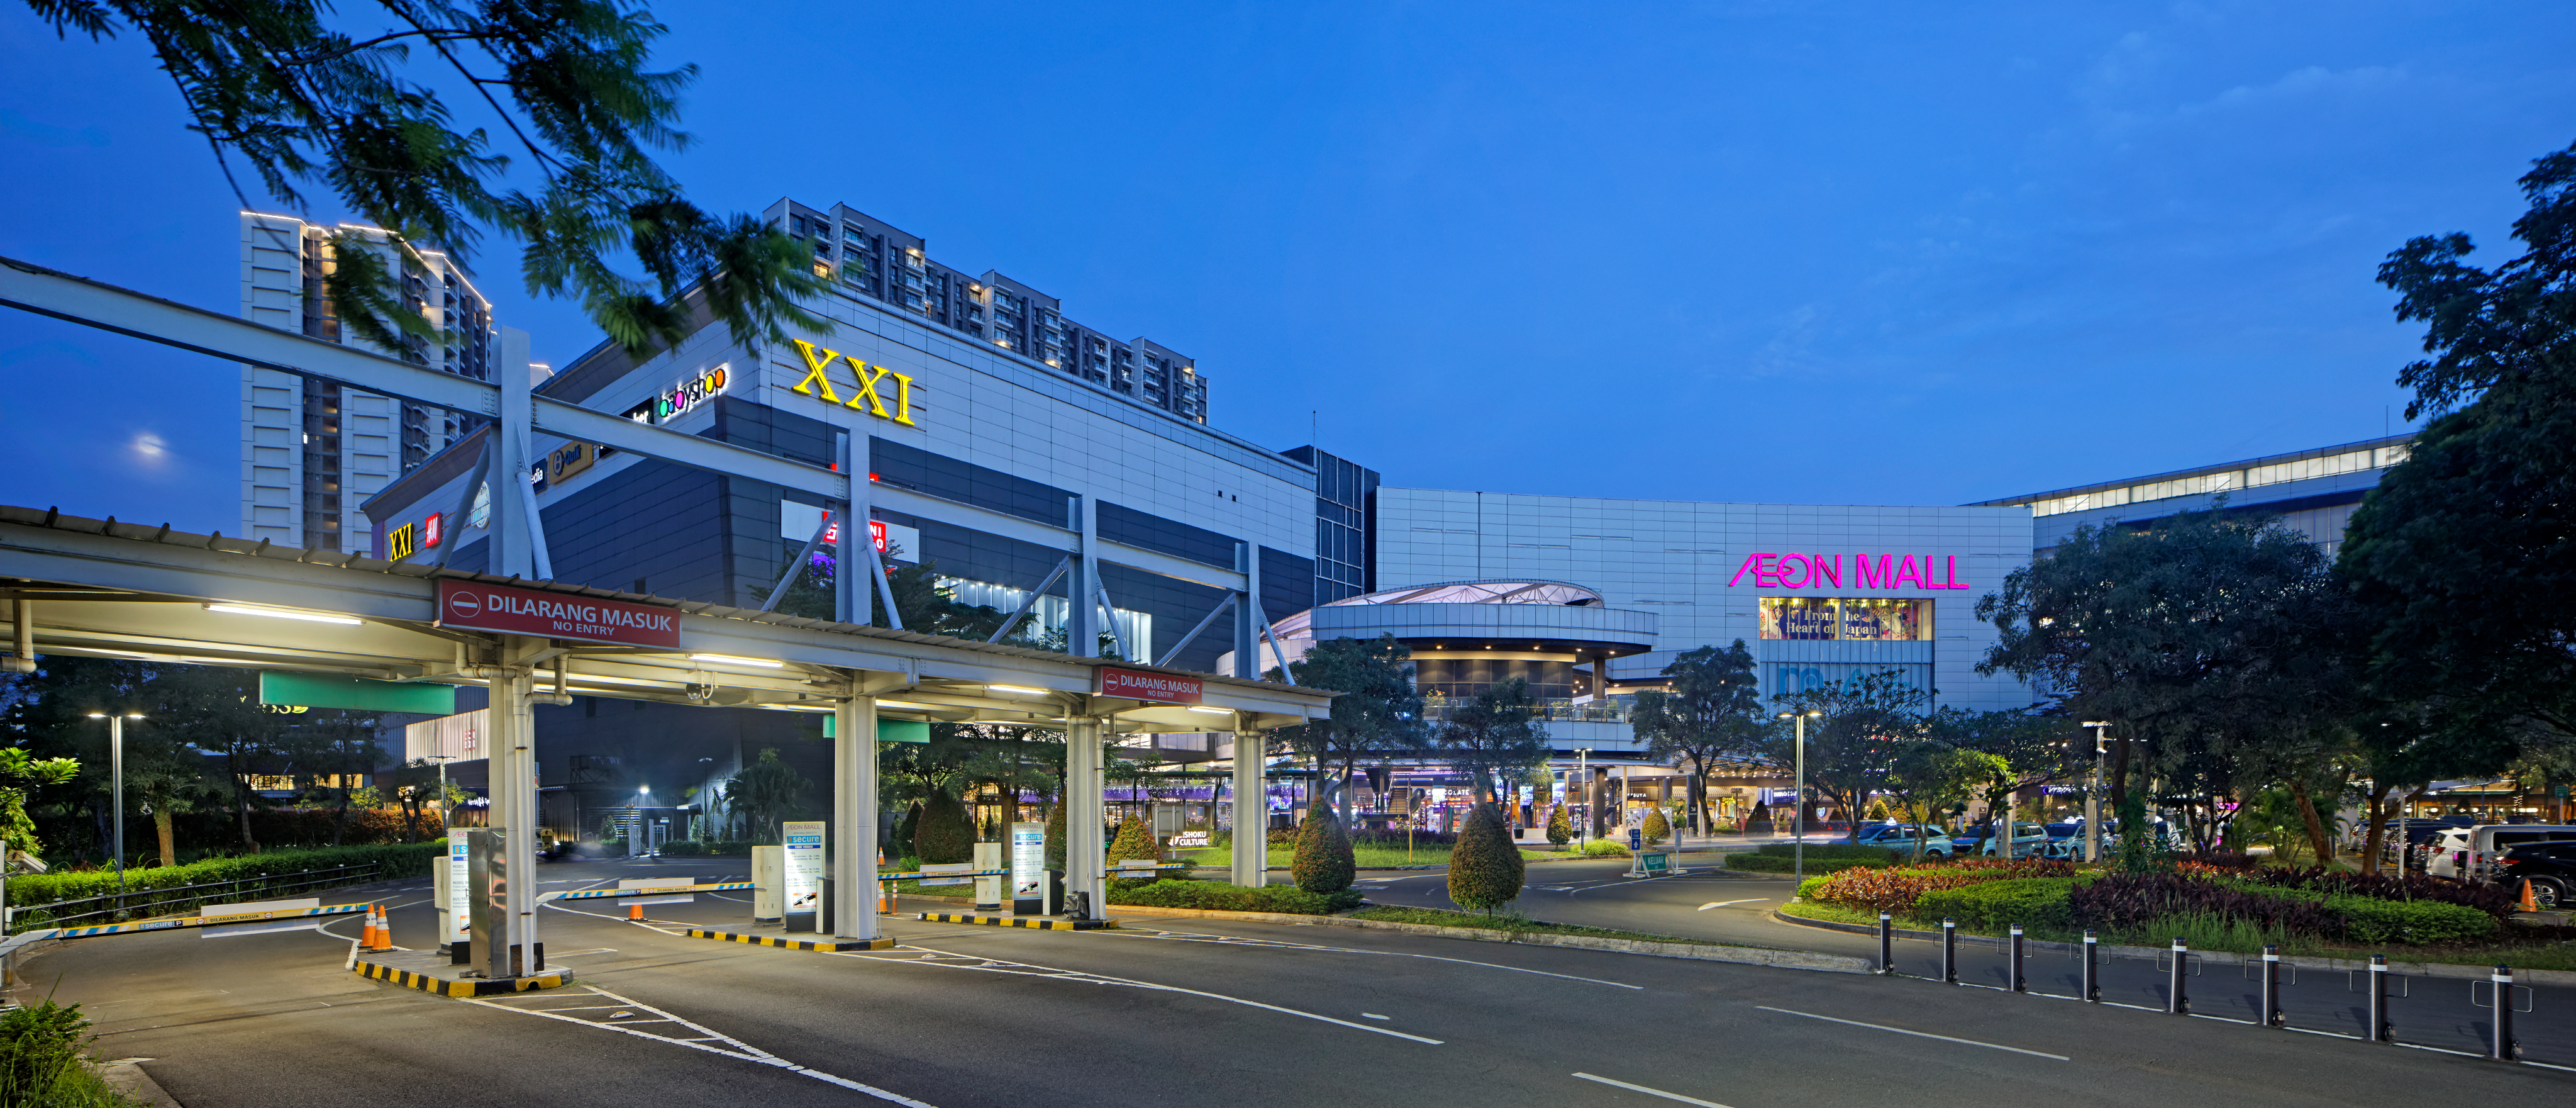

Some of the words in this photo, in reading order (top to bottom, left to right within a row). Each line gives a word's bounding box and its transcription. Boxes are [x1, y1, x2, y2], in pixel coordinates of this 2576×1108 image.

[660, 367, 725, 417] babyshop
[792, 339, 914, 425] XXI
[553, 444, 581, 476] B-Quik
[389, 522, 412, 562] XXI
[1857, 554, 1969, 589] MALL
[488, 594, 596, 623] DILARANG
[602, 608, 672, 632] MASUK
[553, 620, 572, 631] NO
[576, 623, 615, 636] ENTRY
[1786, 622, 1819, 633] Heart
[1824, 623, 1835, 633] of
[1804, 610, 1835, 620] From
[1845, 610, 1859, 621] he
[1121, 674, 1166, 690] DILARANG
[1169, 680, 1199, 694] MASUK
[1648, 856, 1664, 865] KELUAR
